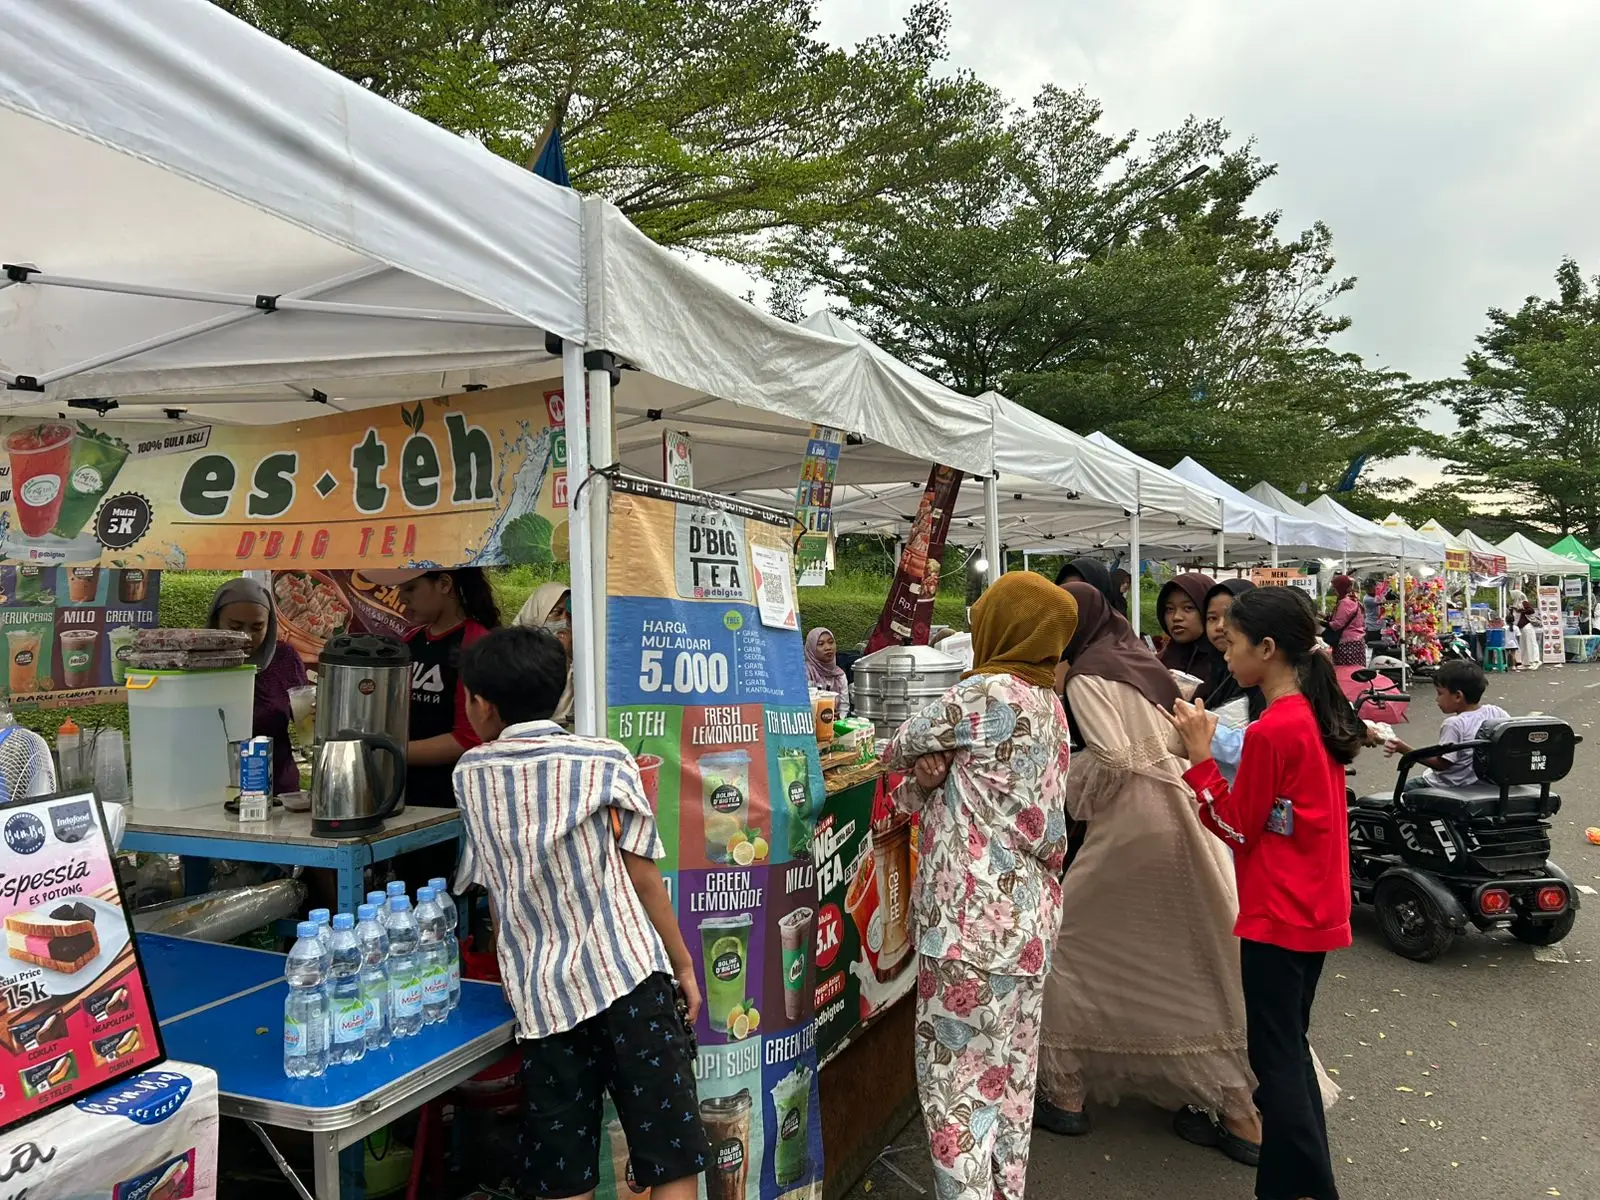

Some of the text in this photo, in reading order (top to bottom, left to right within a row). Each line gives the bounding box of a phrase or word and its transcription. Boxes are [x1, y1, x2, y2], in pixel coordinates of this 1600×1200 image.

[138, 431, 205, 454] 100% GULA ASLI
[178, 411, 496, 519] es teh
[112, 507, 137, 517] Mulai
[107, 517, 134, 535] 5K
[236, 524, 417, 560] D'BIG TEA
[689, 525, 738, 557] D'BIG
[689, 557, 741, 589] TEA
[1271, 571, 1288, 579] MENU
[63, 610, 96, 624] MILO
[105, 610, 153, 624] GREEN TEA
[642, 620, 687, 635] HARGA
[641, 636, 711, 651] MULAI DARI
[639, 650, 729, 694] 5.000
[619, 710, 666, 739] ES TEH
[704, 706, 741, 727] FRESH
[765, 710, 780, 735] TEH
[779, 711, 814, 736] HIJAU
[692, 722, 760, 745] LEMONADE
[56, 813, 90, 828] Indofood
[706, 871, 751, 893] GREEN
[816, 852, 844, 902] TEA
[29, 883, 83, 906] ES POTONG
[690, 888, 763, 912] LEMONADE
[19, 968, 42, 981] Price
[4, 980, 50, 1012] 15k
[765, 1023, 815, 1065] GREEN TEA
[694, 1044, 760, 1080] OPI SUSU
[154, 1084, 189, 1118] CREAM
[719, 1143, 741, 1157] BOLING
